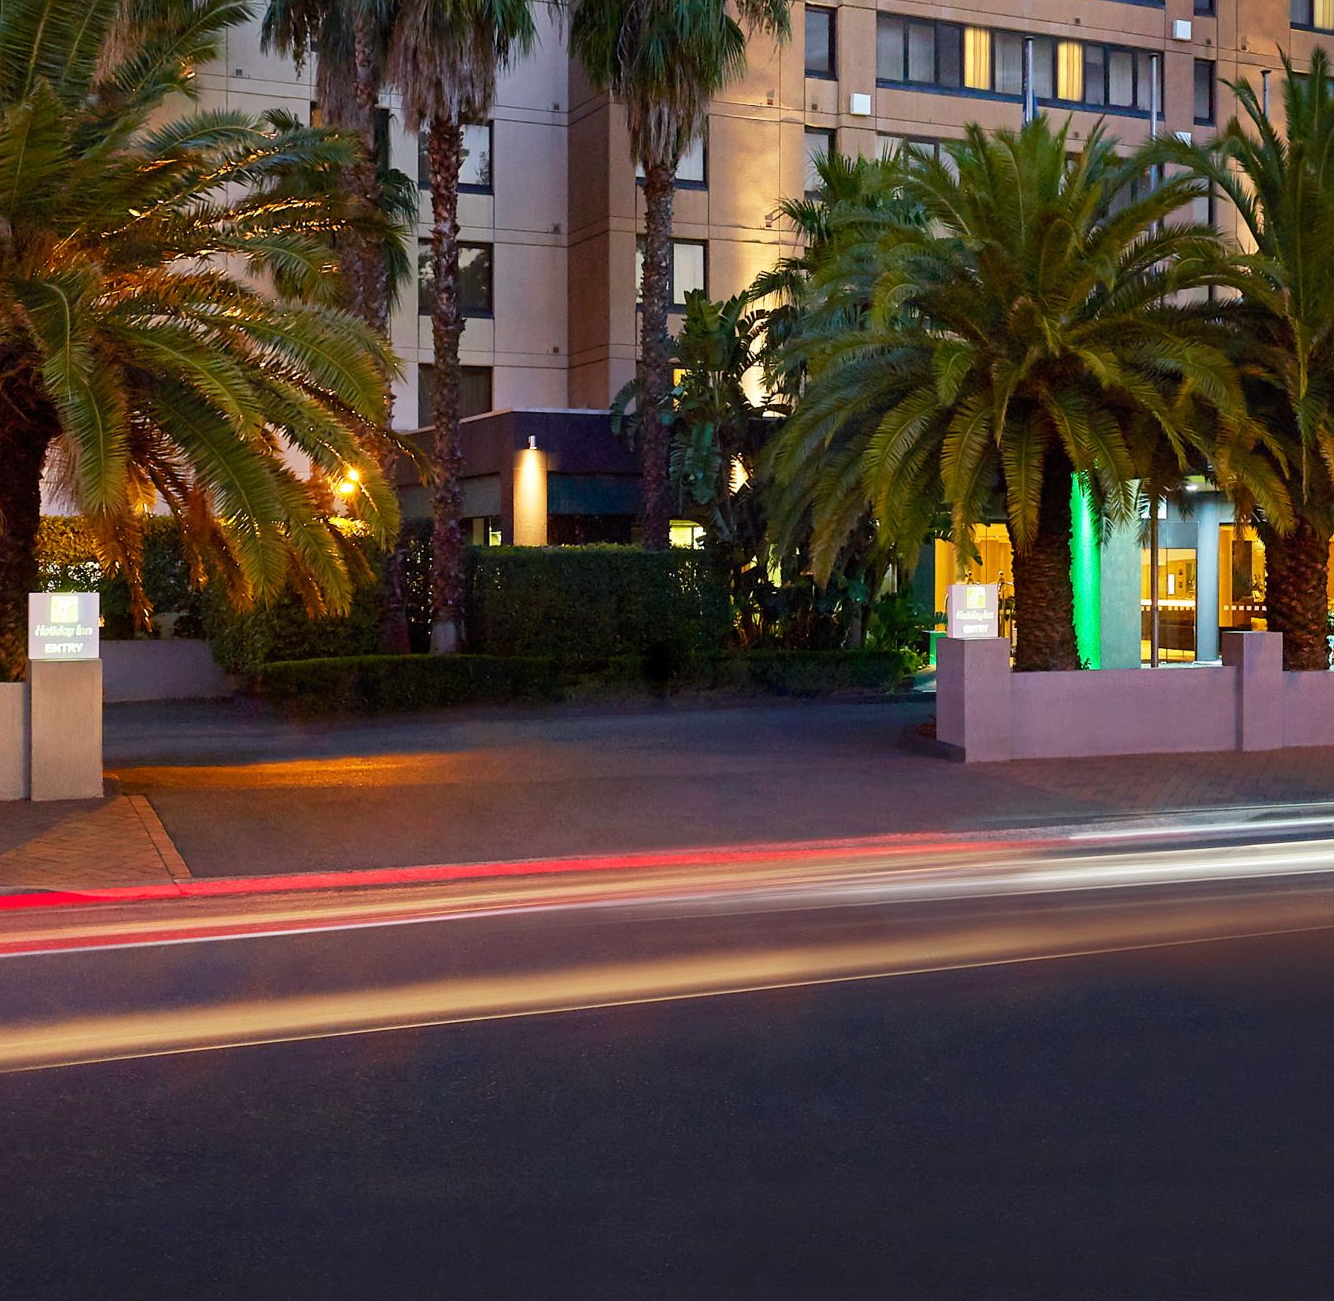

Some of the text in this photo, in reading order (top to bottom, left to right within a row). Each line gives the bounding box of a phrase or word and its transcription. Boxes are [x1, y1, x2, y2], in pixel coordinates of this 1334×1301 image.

[34, 624, 94, 638] Holiday Inn
[962, 623, 989, 634] ENTRY
[44, 642, 84, 654] ENTRY
